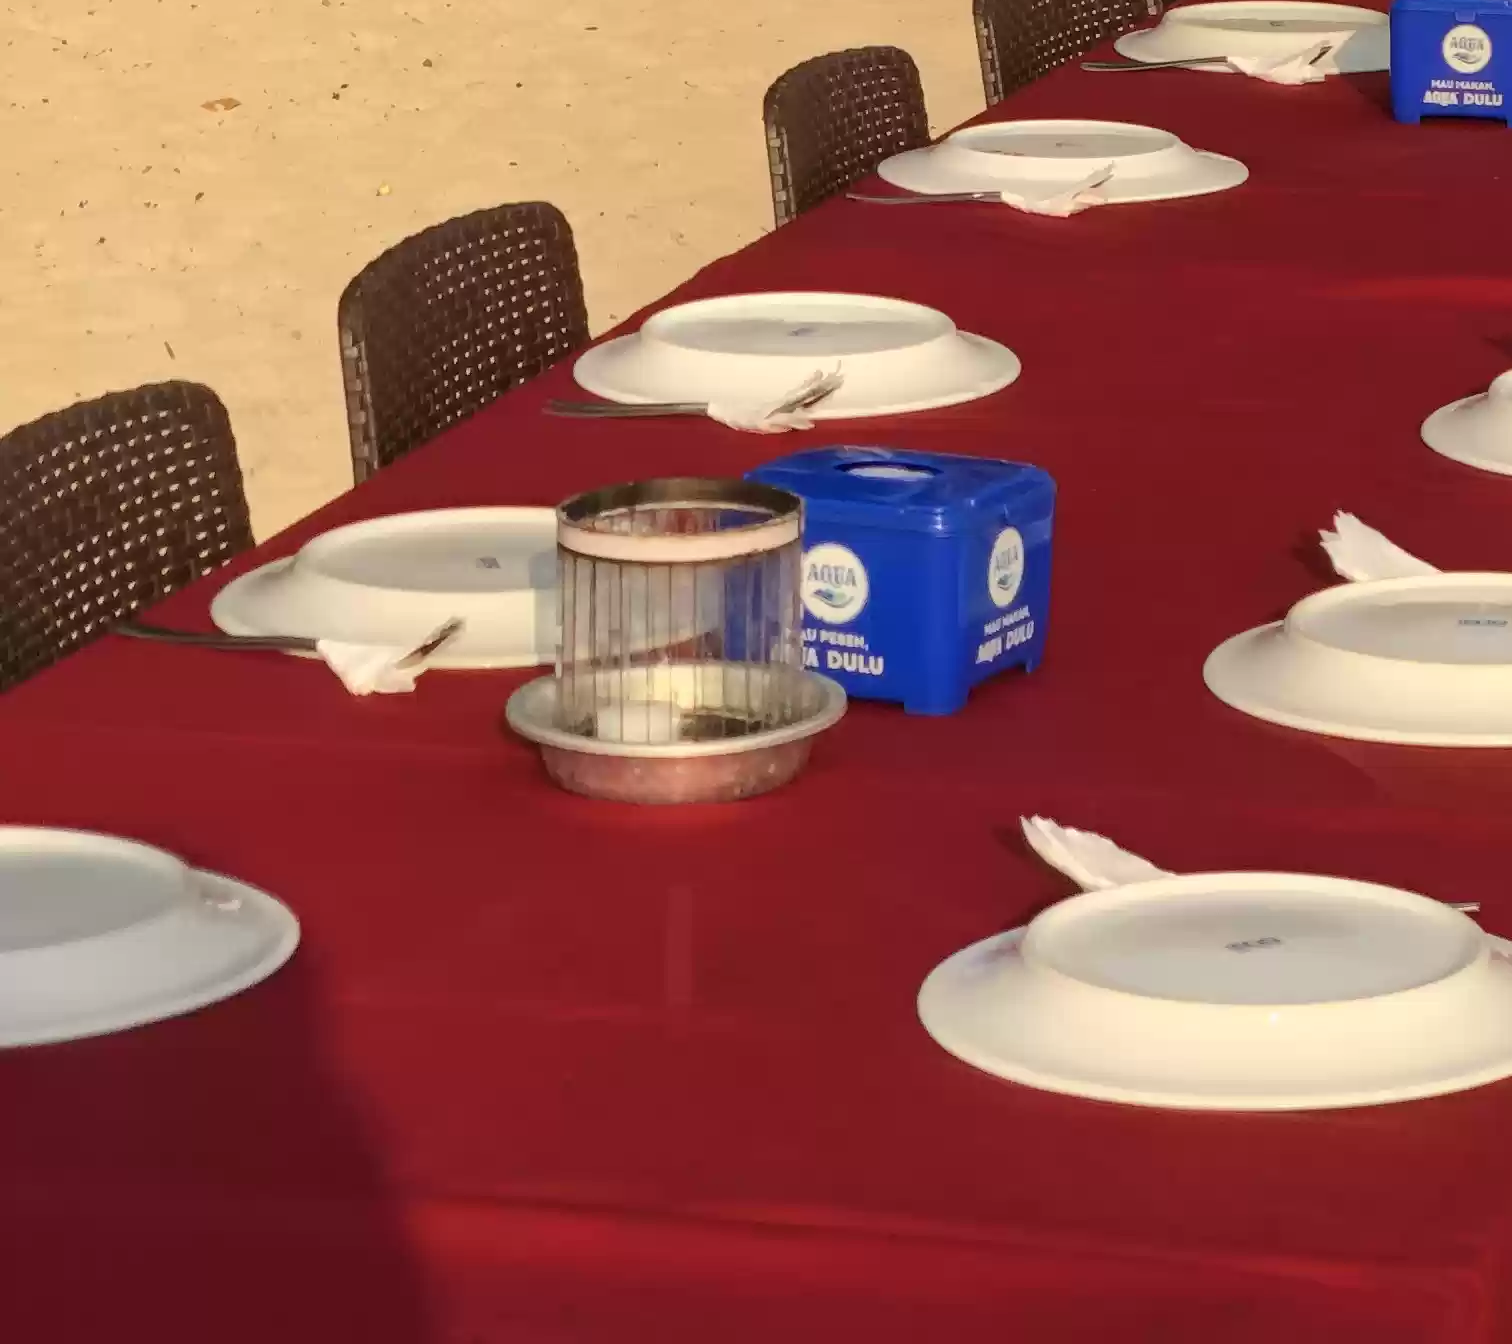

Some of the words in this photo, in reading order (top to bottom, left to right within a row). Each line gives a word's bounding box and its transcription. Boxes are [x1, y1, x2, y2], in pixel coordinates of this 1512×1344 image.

[1450, 36, 1484, 50] AQUA
[1463, 92, 1503, 106] DULU
[807, 563, 857, 588] AQUA
[827, 650, 884, 675] DULU
